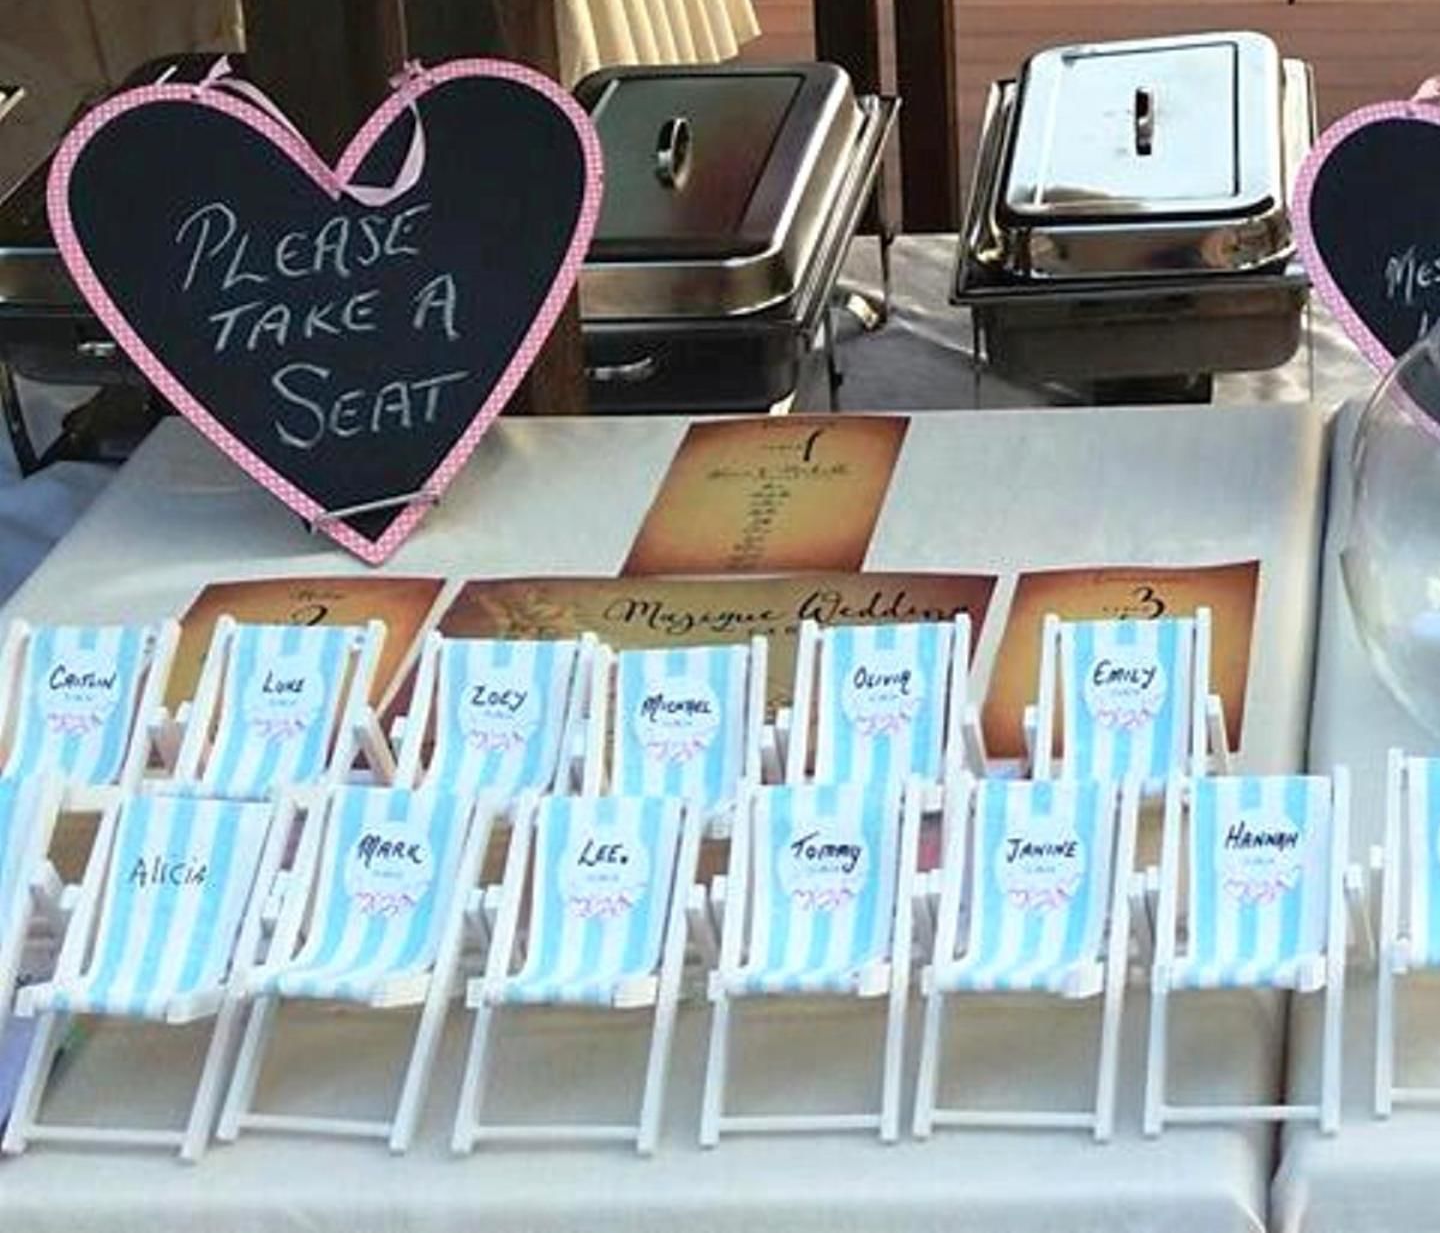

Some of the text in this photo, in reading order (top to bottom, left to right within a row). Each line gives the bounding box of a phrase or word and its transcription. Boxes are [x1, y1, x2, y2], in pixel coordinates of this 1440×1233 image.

[176, 202, 430, 291] PLEASE
[210, 274, 460, 351] TAKE A
[271, 363, 470, 448] SEAT
[1131, 587, 1166, 618] 3
[1093, 659, 1157, 689] EMILY
[471, 686, 528, 712] ZOEY
[1006, 836, 1079, 864] JANINE
[1225, 820, 1299, 853] HANNAH
